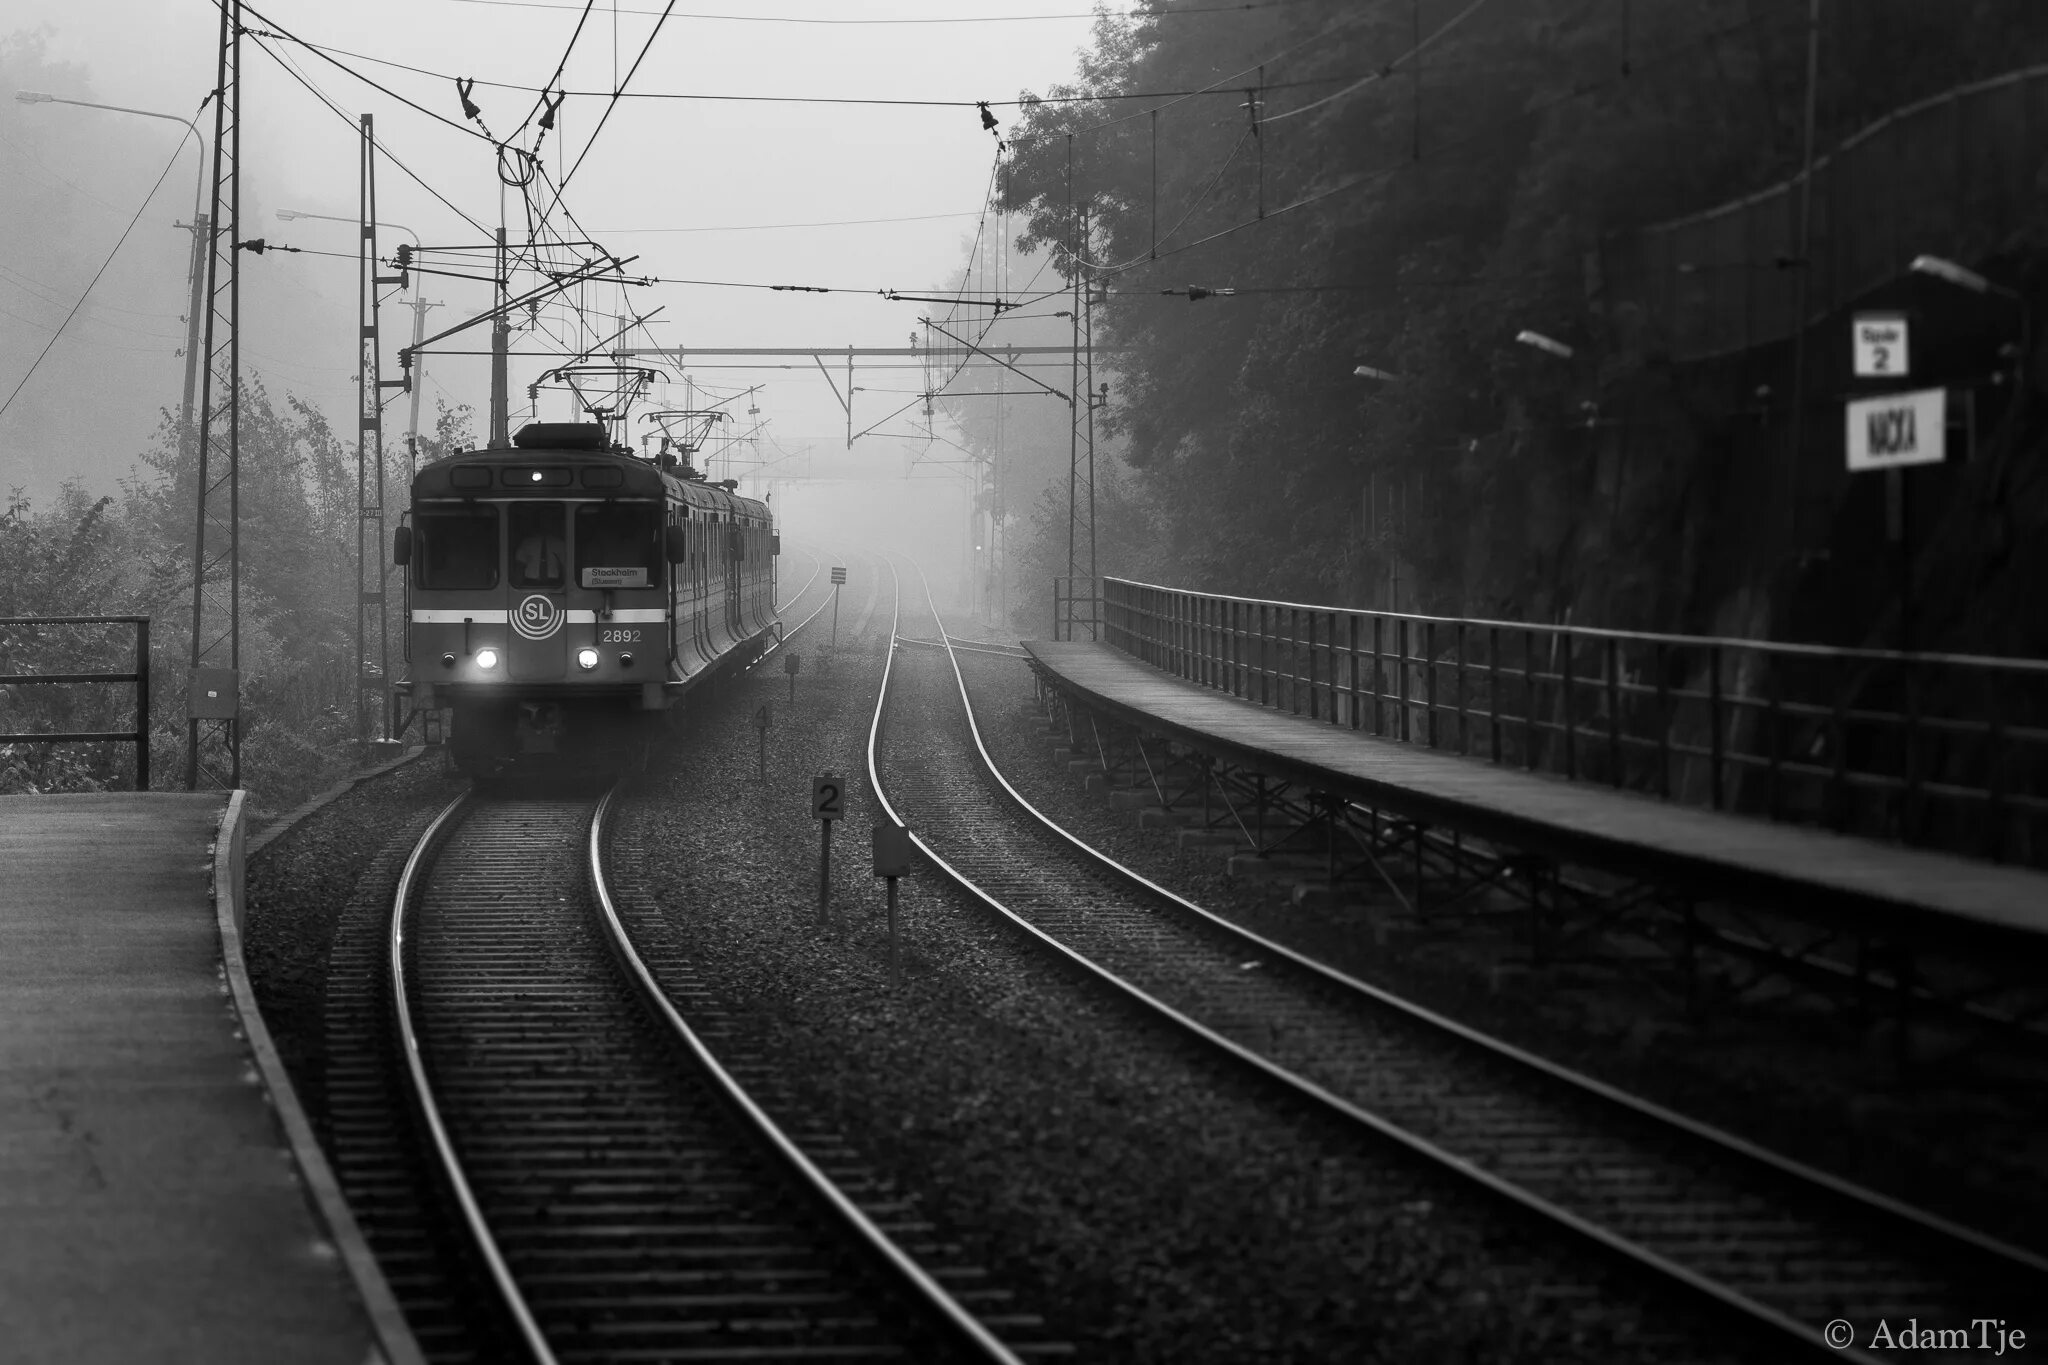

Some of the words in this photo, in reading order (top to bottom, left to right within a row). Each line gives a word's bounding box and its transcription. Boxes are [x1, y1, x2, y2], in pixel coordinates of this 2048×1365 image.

[1873, 346, 1890, 370] 2
[591, 568, 638, 577] Stockholm
[525, 603, 549, 621] SL
[603, 630, 641, 643] 2892
[818, 784, 839, 812] 2
